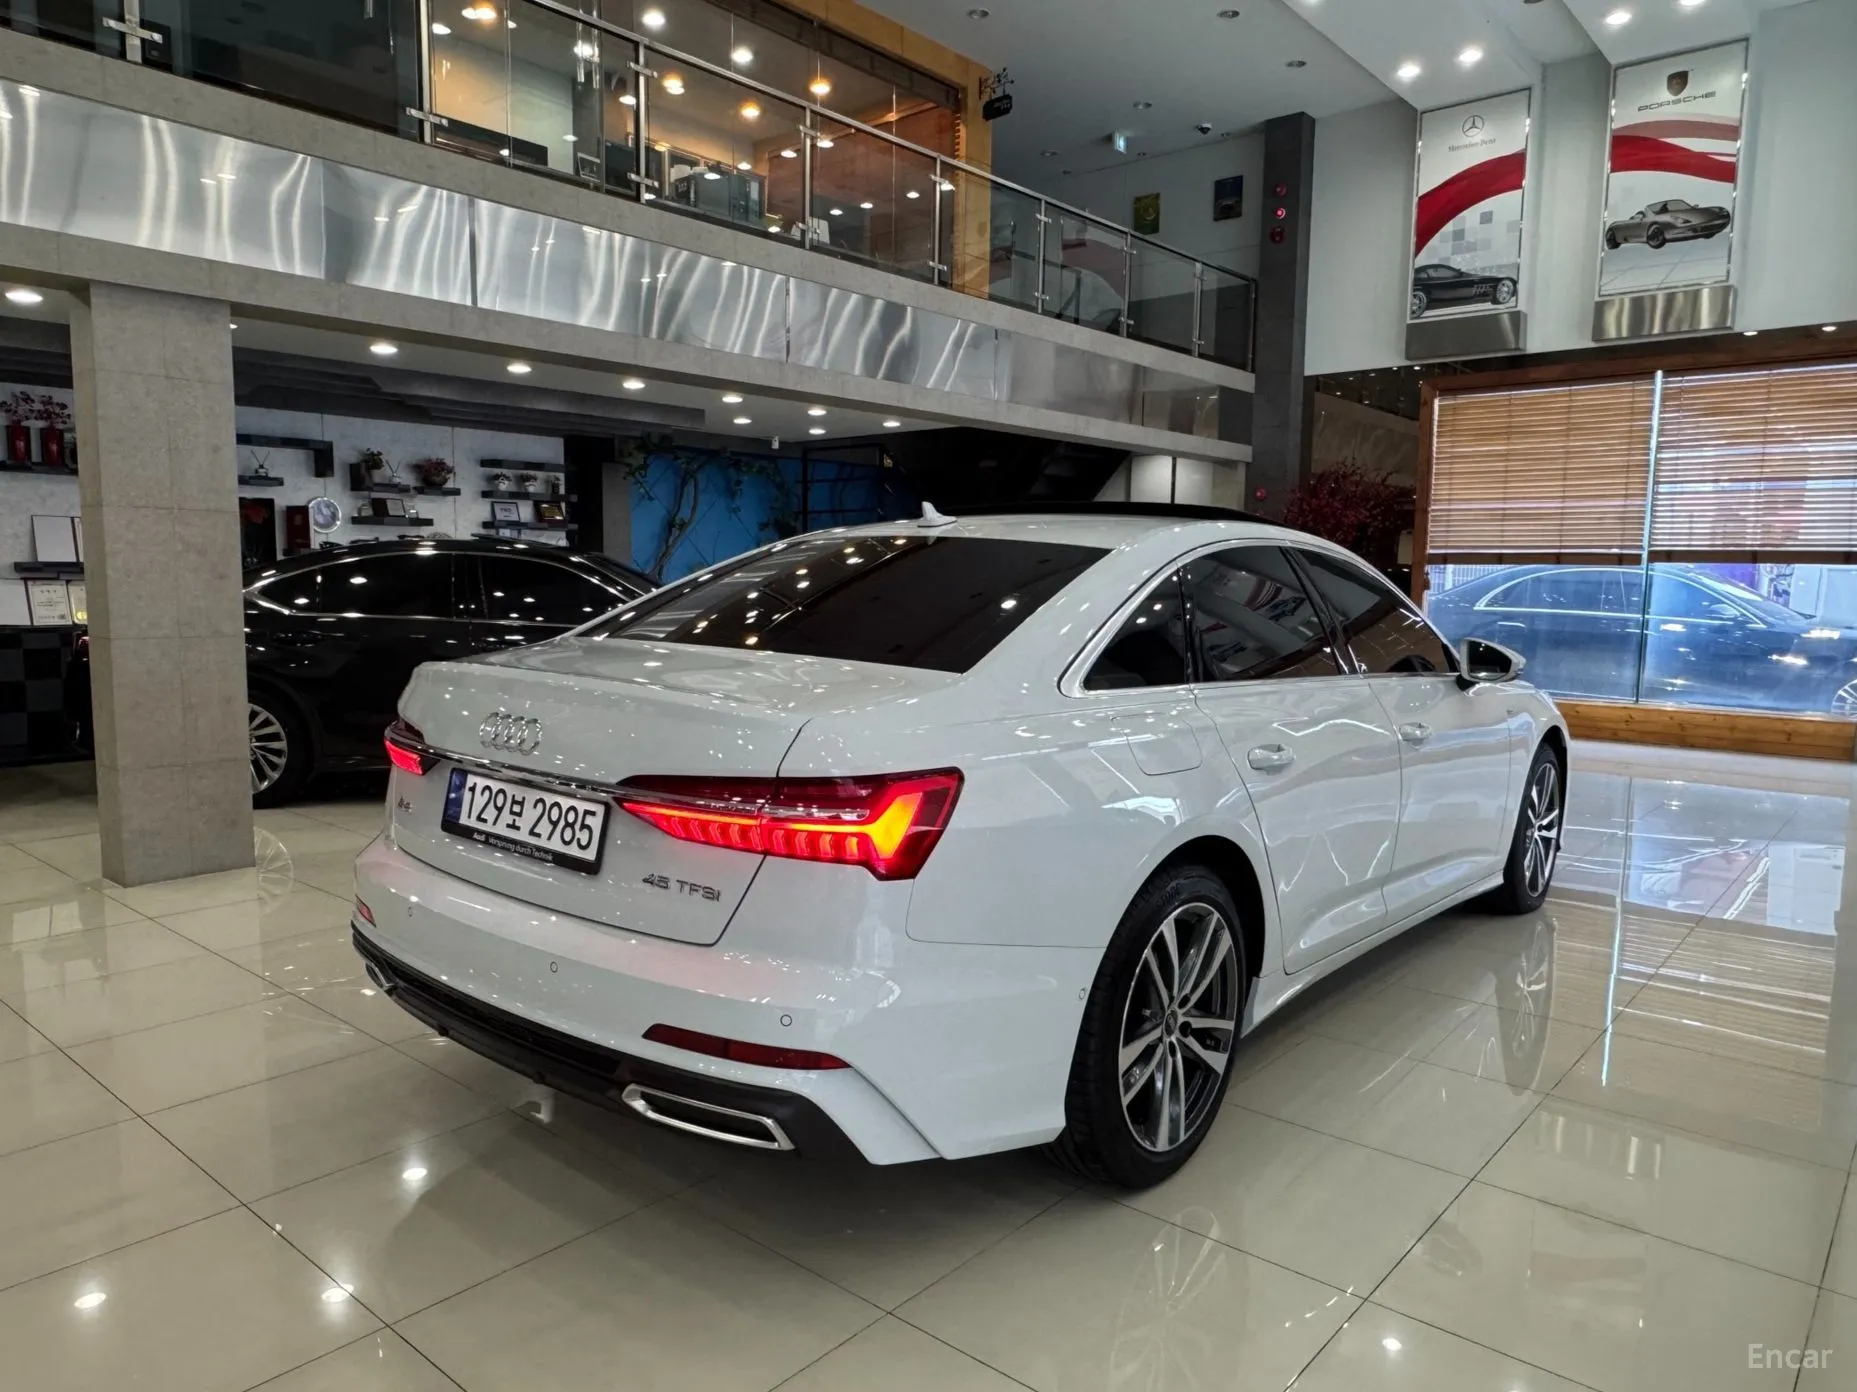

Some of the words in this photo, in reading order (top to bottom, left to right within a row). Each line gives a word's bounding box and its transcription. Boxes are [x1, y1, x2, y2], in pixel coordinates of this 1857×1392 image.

[1637, 91, 1716, 113] PORSCHE
[467, 782, 526, 831] 129보
[528, 797, 596, 850] 2985
[642, 873, 670, 889] 45
[676, 879, 721, 902] TFSI
